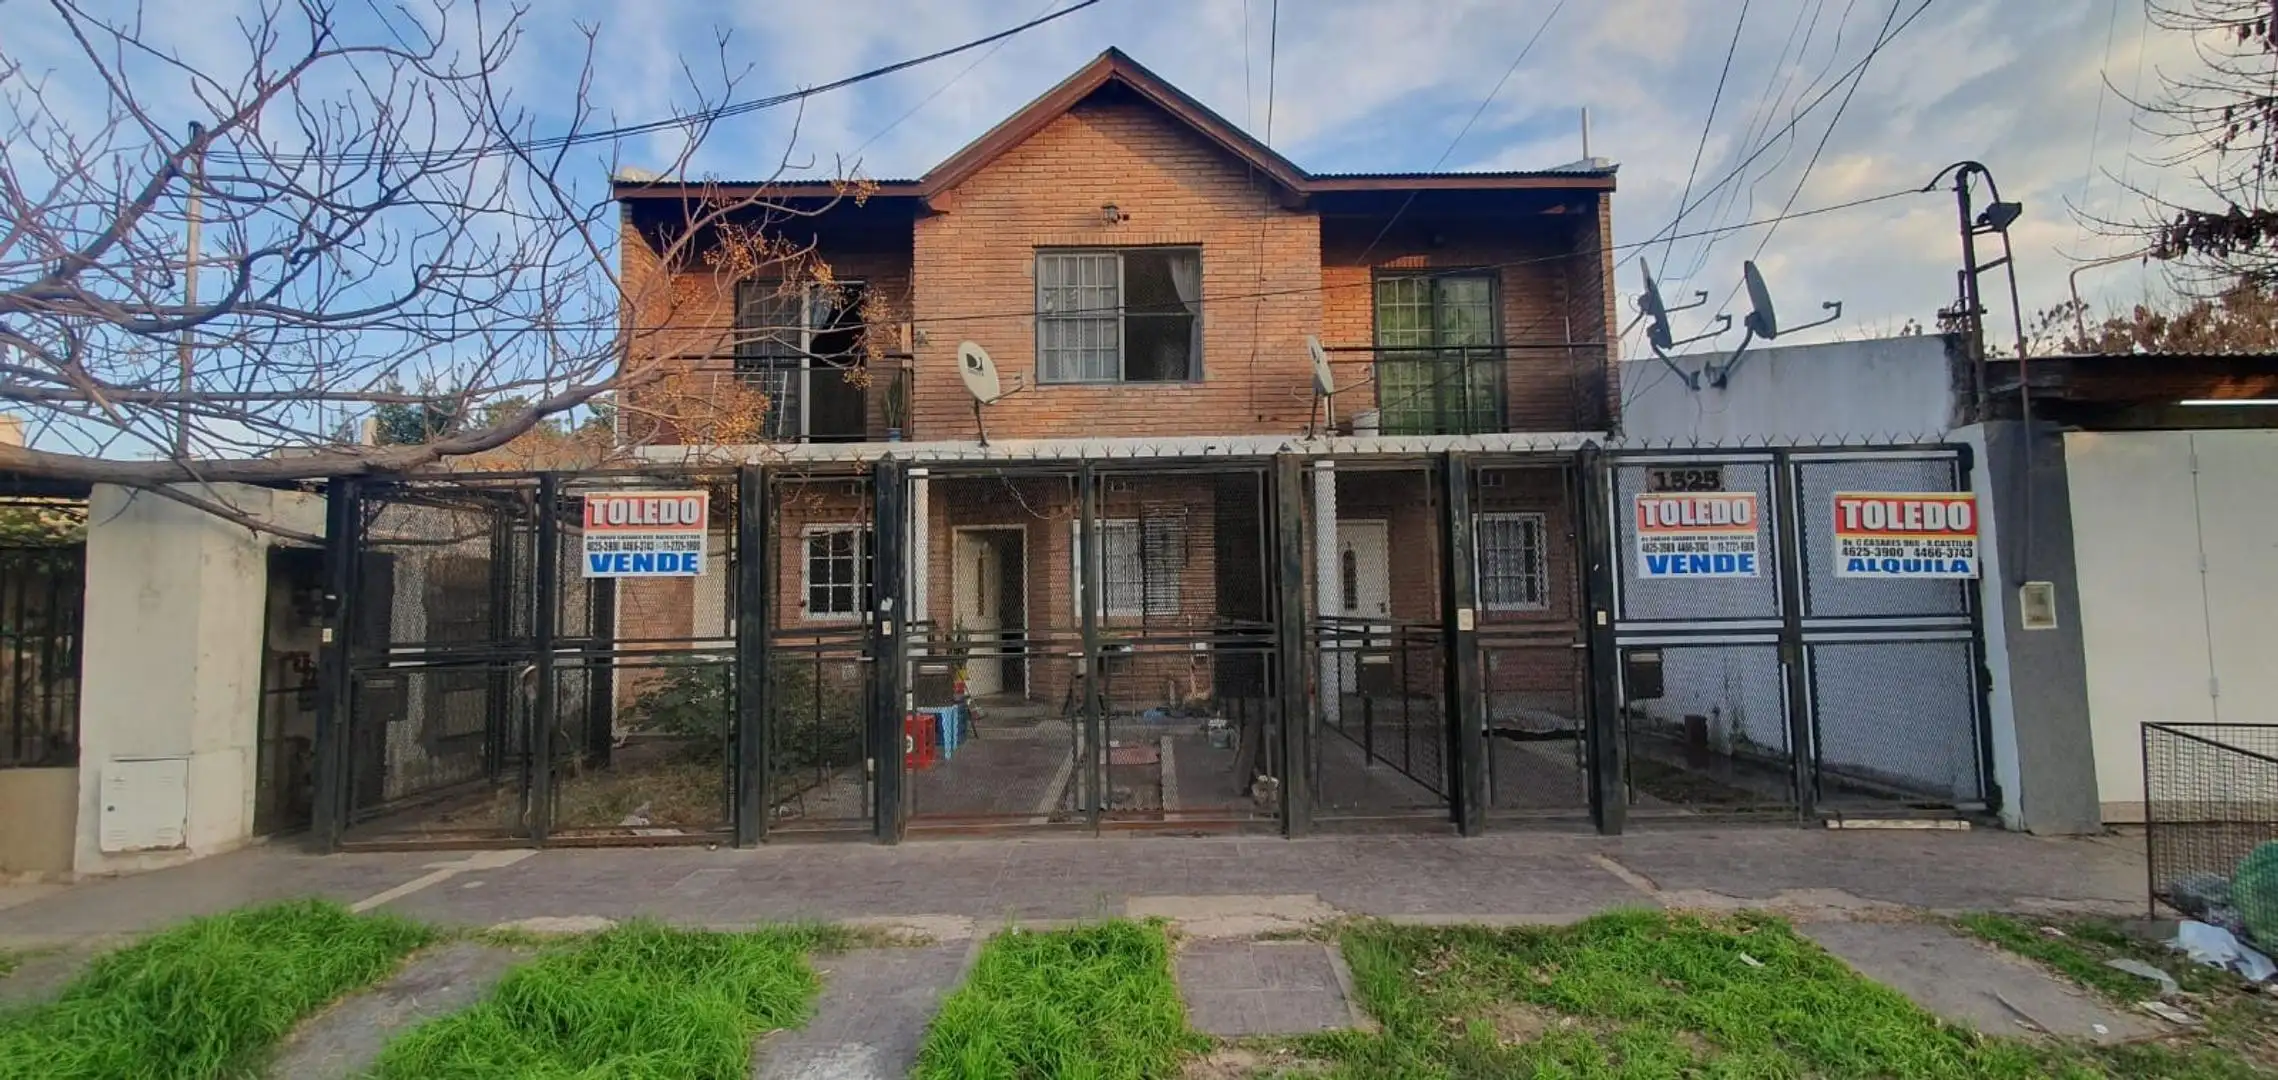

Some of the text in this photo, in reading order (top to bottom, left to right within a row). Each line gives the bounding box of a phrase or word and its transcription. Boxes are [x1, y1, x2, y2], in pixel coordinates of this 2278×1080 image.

[1653, 470, 1720, 491] 1525
[587, 498, 700, 525] TOLEDO
[1639, 499, 1751, 527] TOLEDO
[1840, 500, 1971, 531] TOLEDO
[590, 553, 698, 572] VENDE
[1913, 548, 1973, 558] 4466-3743
[1646, 554, 1754, 574] VENDE
[1847, 558, 1970, 573] ALQUILA
